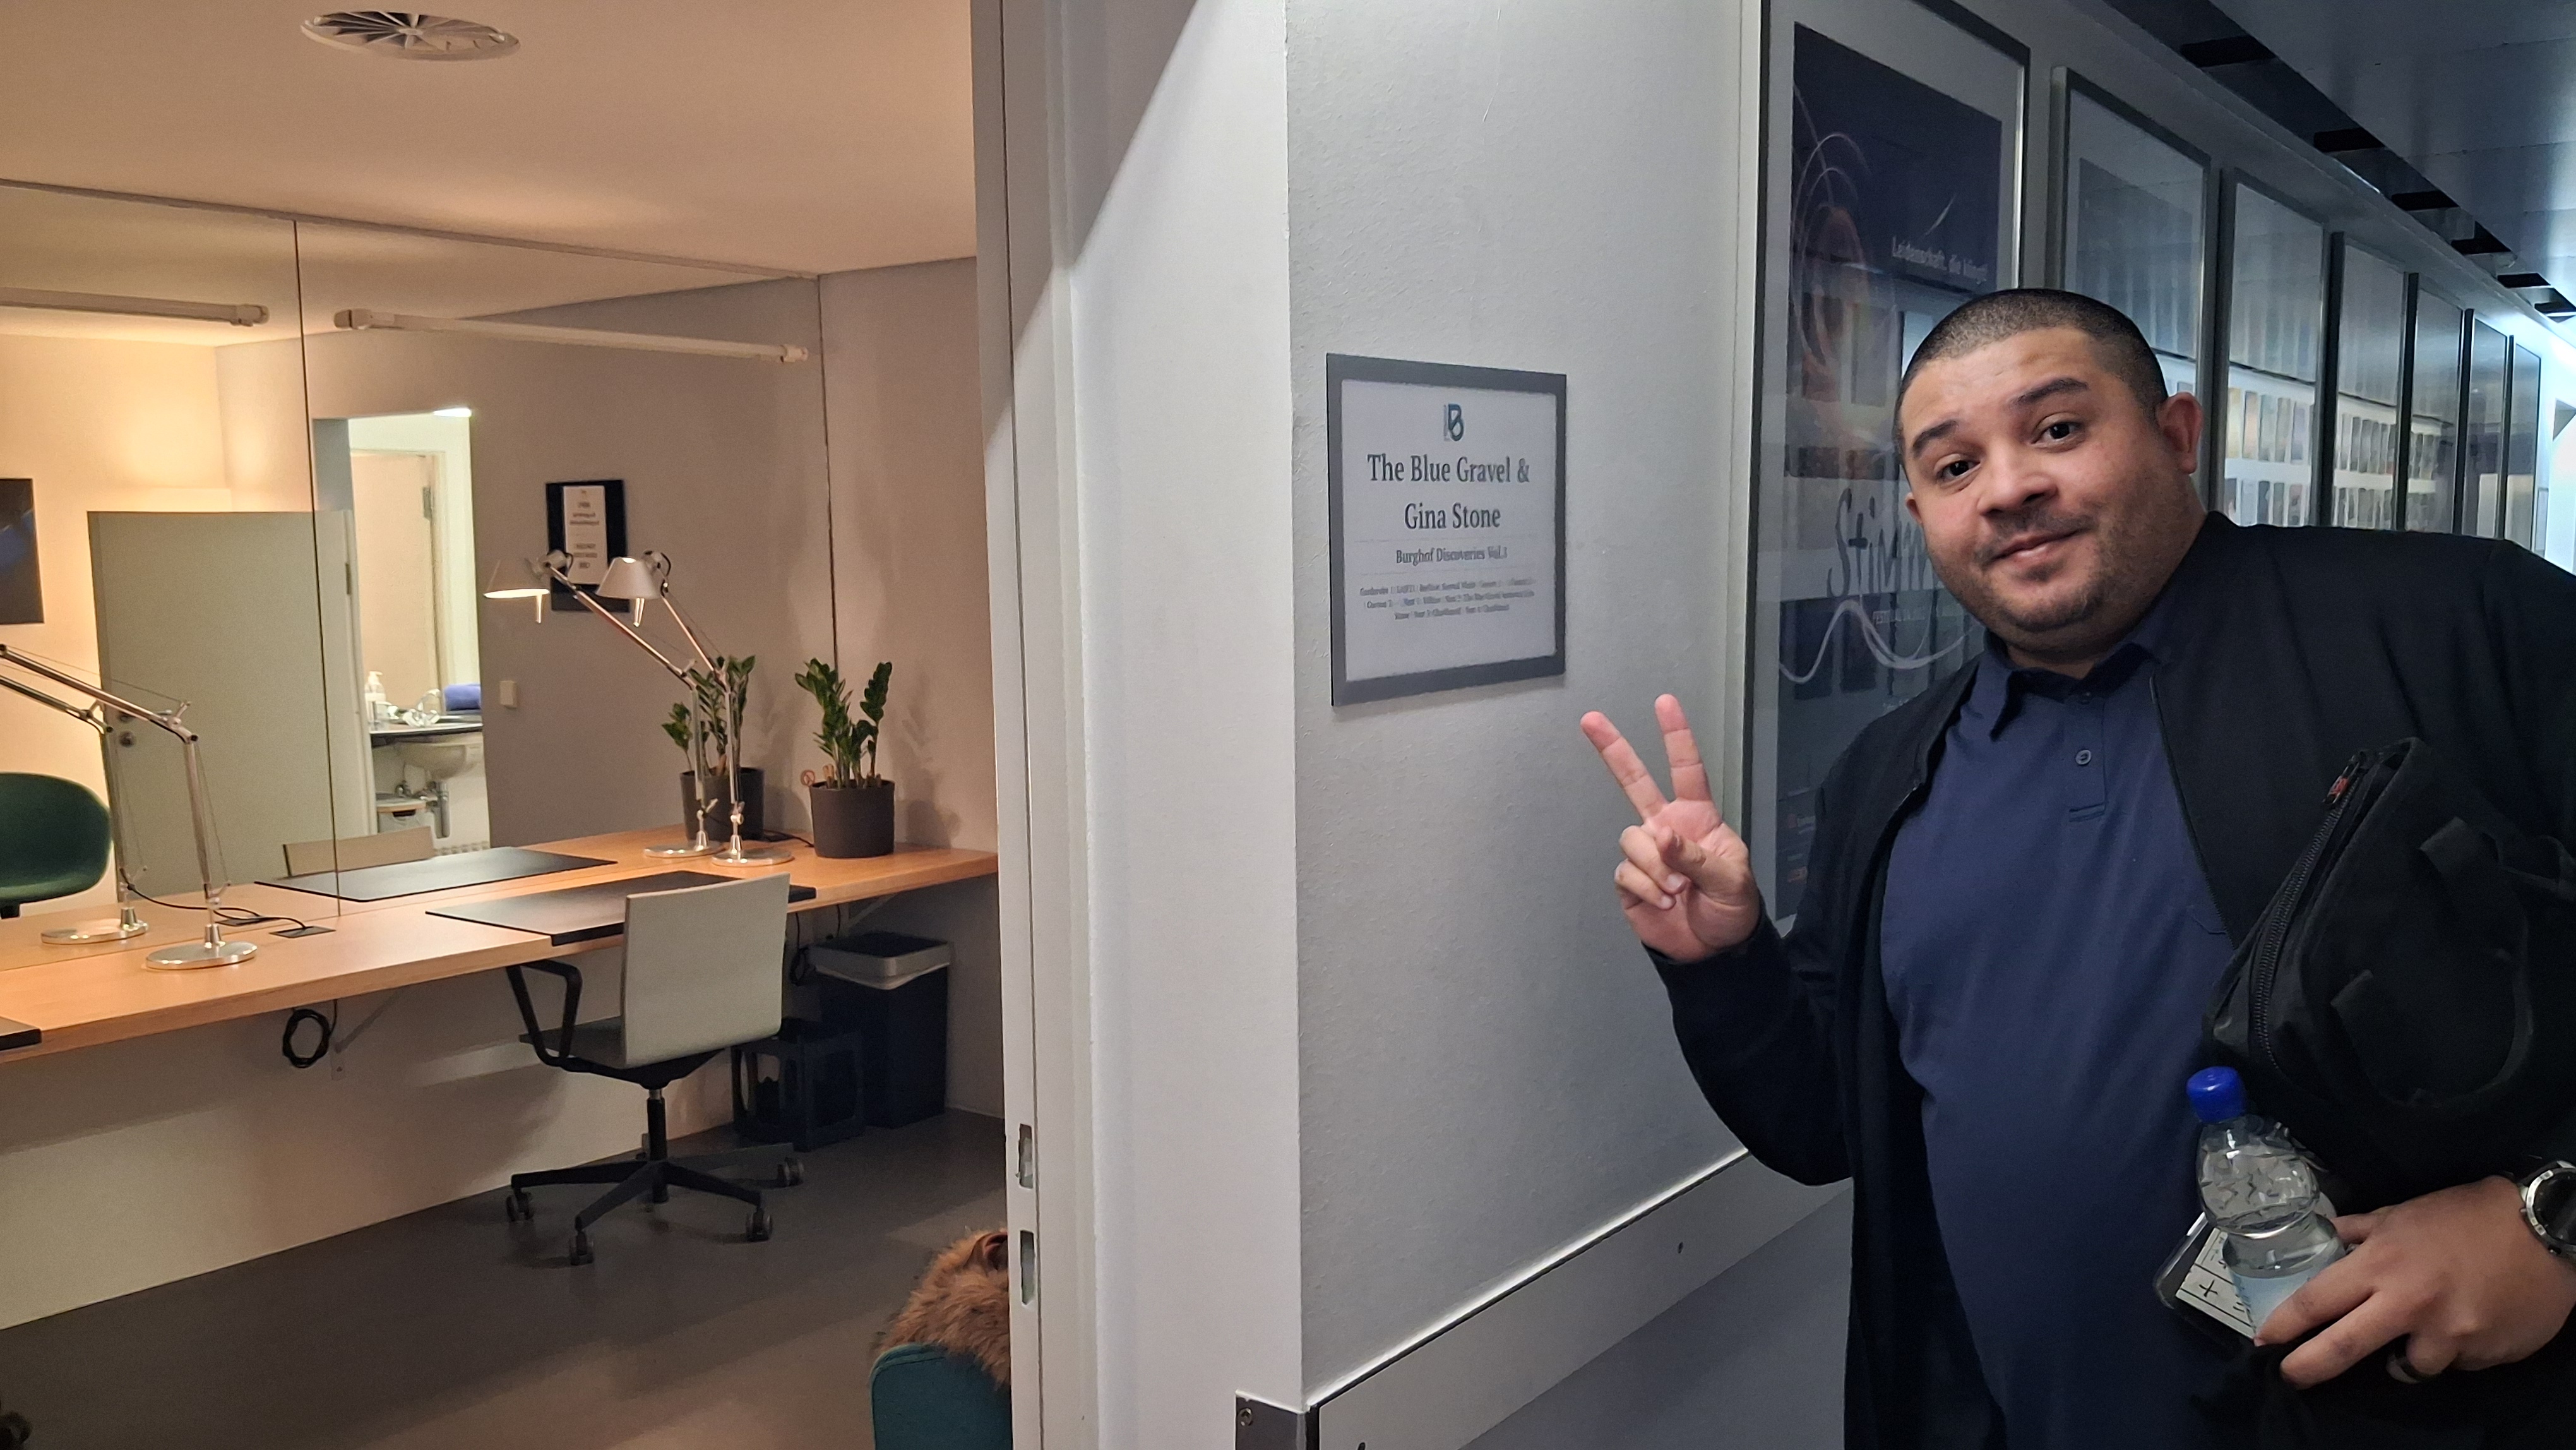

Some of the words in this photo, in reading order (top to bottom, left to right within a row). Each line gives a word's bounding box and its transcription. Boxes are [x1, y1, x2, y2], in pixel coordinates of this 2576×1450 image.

[1367, 453, 1404, 481] The
[1410, 454, 1450, 482] Blue
[1457, 456, 1510, 483] Gravel
[1517, 458, 1530, 483] &
[1404, 503, 1446, 529] Gina
[1452, 502, 1501, 529] Stone
[1396, 548, 1434, 566] Burghof
